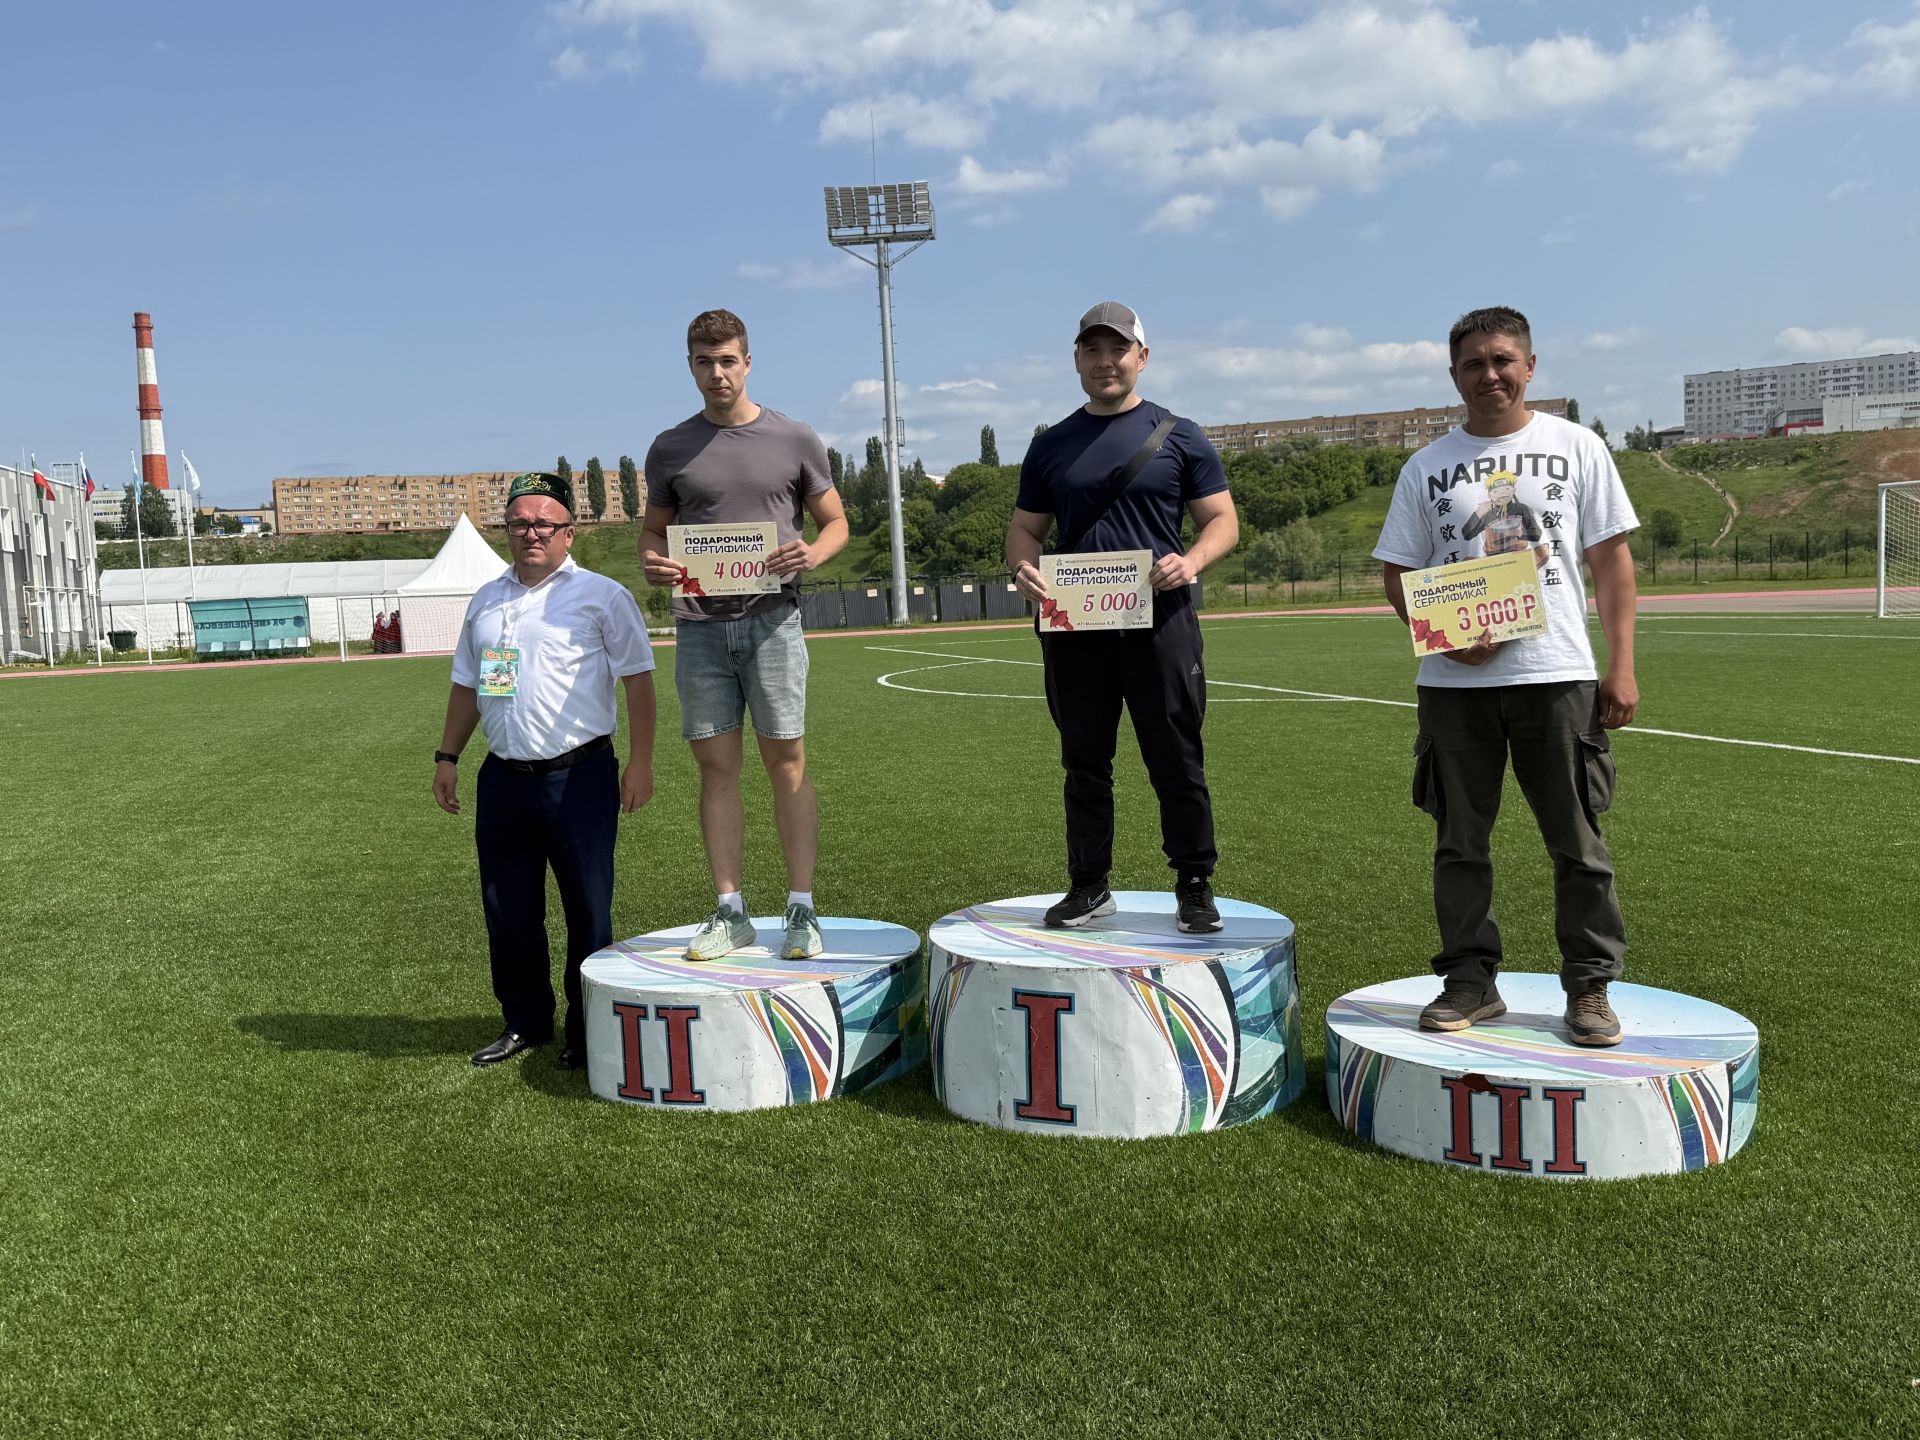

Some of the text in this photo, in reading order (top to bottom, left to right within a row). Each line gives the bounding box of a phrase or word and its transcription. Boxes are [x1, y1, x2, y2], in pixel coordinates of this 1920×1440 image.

[1427, 453, 1569, 502] NARUTO
[685, 533, 763, 545] ПОДАРОЧНЫЙ
[685, 544, 765, 555] СЕРТИФИКАТ
[714, 560, 766, 579] 4 000
[1056, 564, 1137, 576] ПОДАРОЧНЫЙ
[1056, 574, 1138, 586] СЕРТИФИКАТ
[1413, 577, 1487, 598] ПОДАРОЧНЫЙ
[1414, 587, 1488, 608] СЕРТИФИКАТ
[1083, 593, 1095, 612] 5
[1100, 592, 1138, 611] 000
[1456, 606, 1471, 631] 3
[1475, 597, 1519, 628] 000
[611, 1000, 707, 1107] II
[1011, 987, 1078, 1127] I
[1440, 1074, 1588, 1176] III
